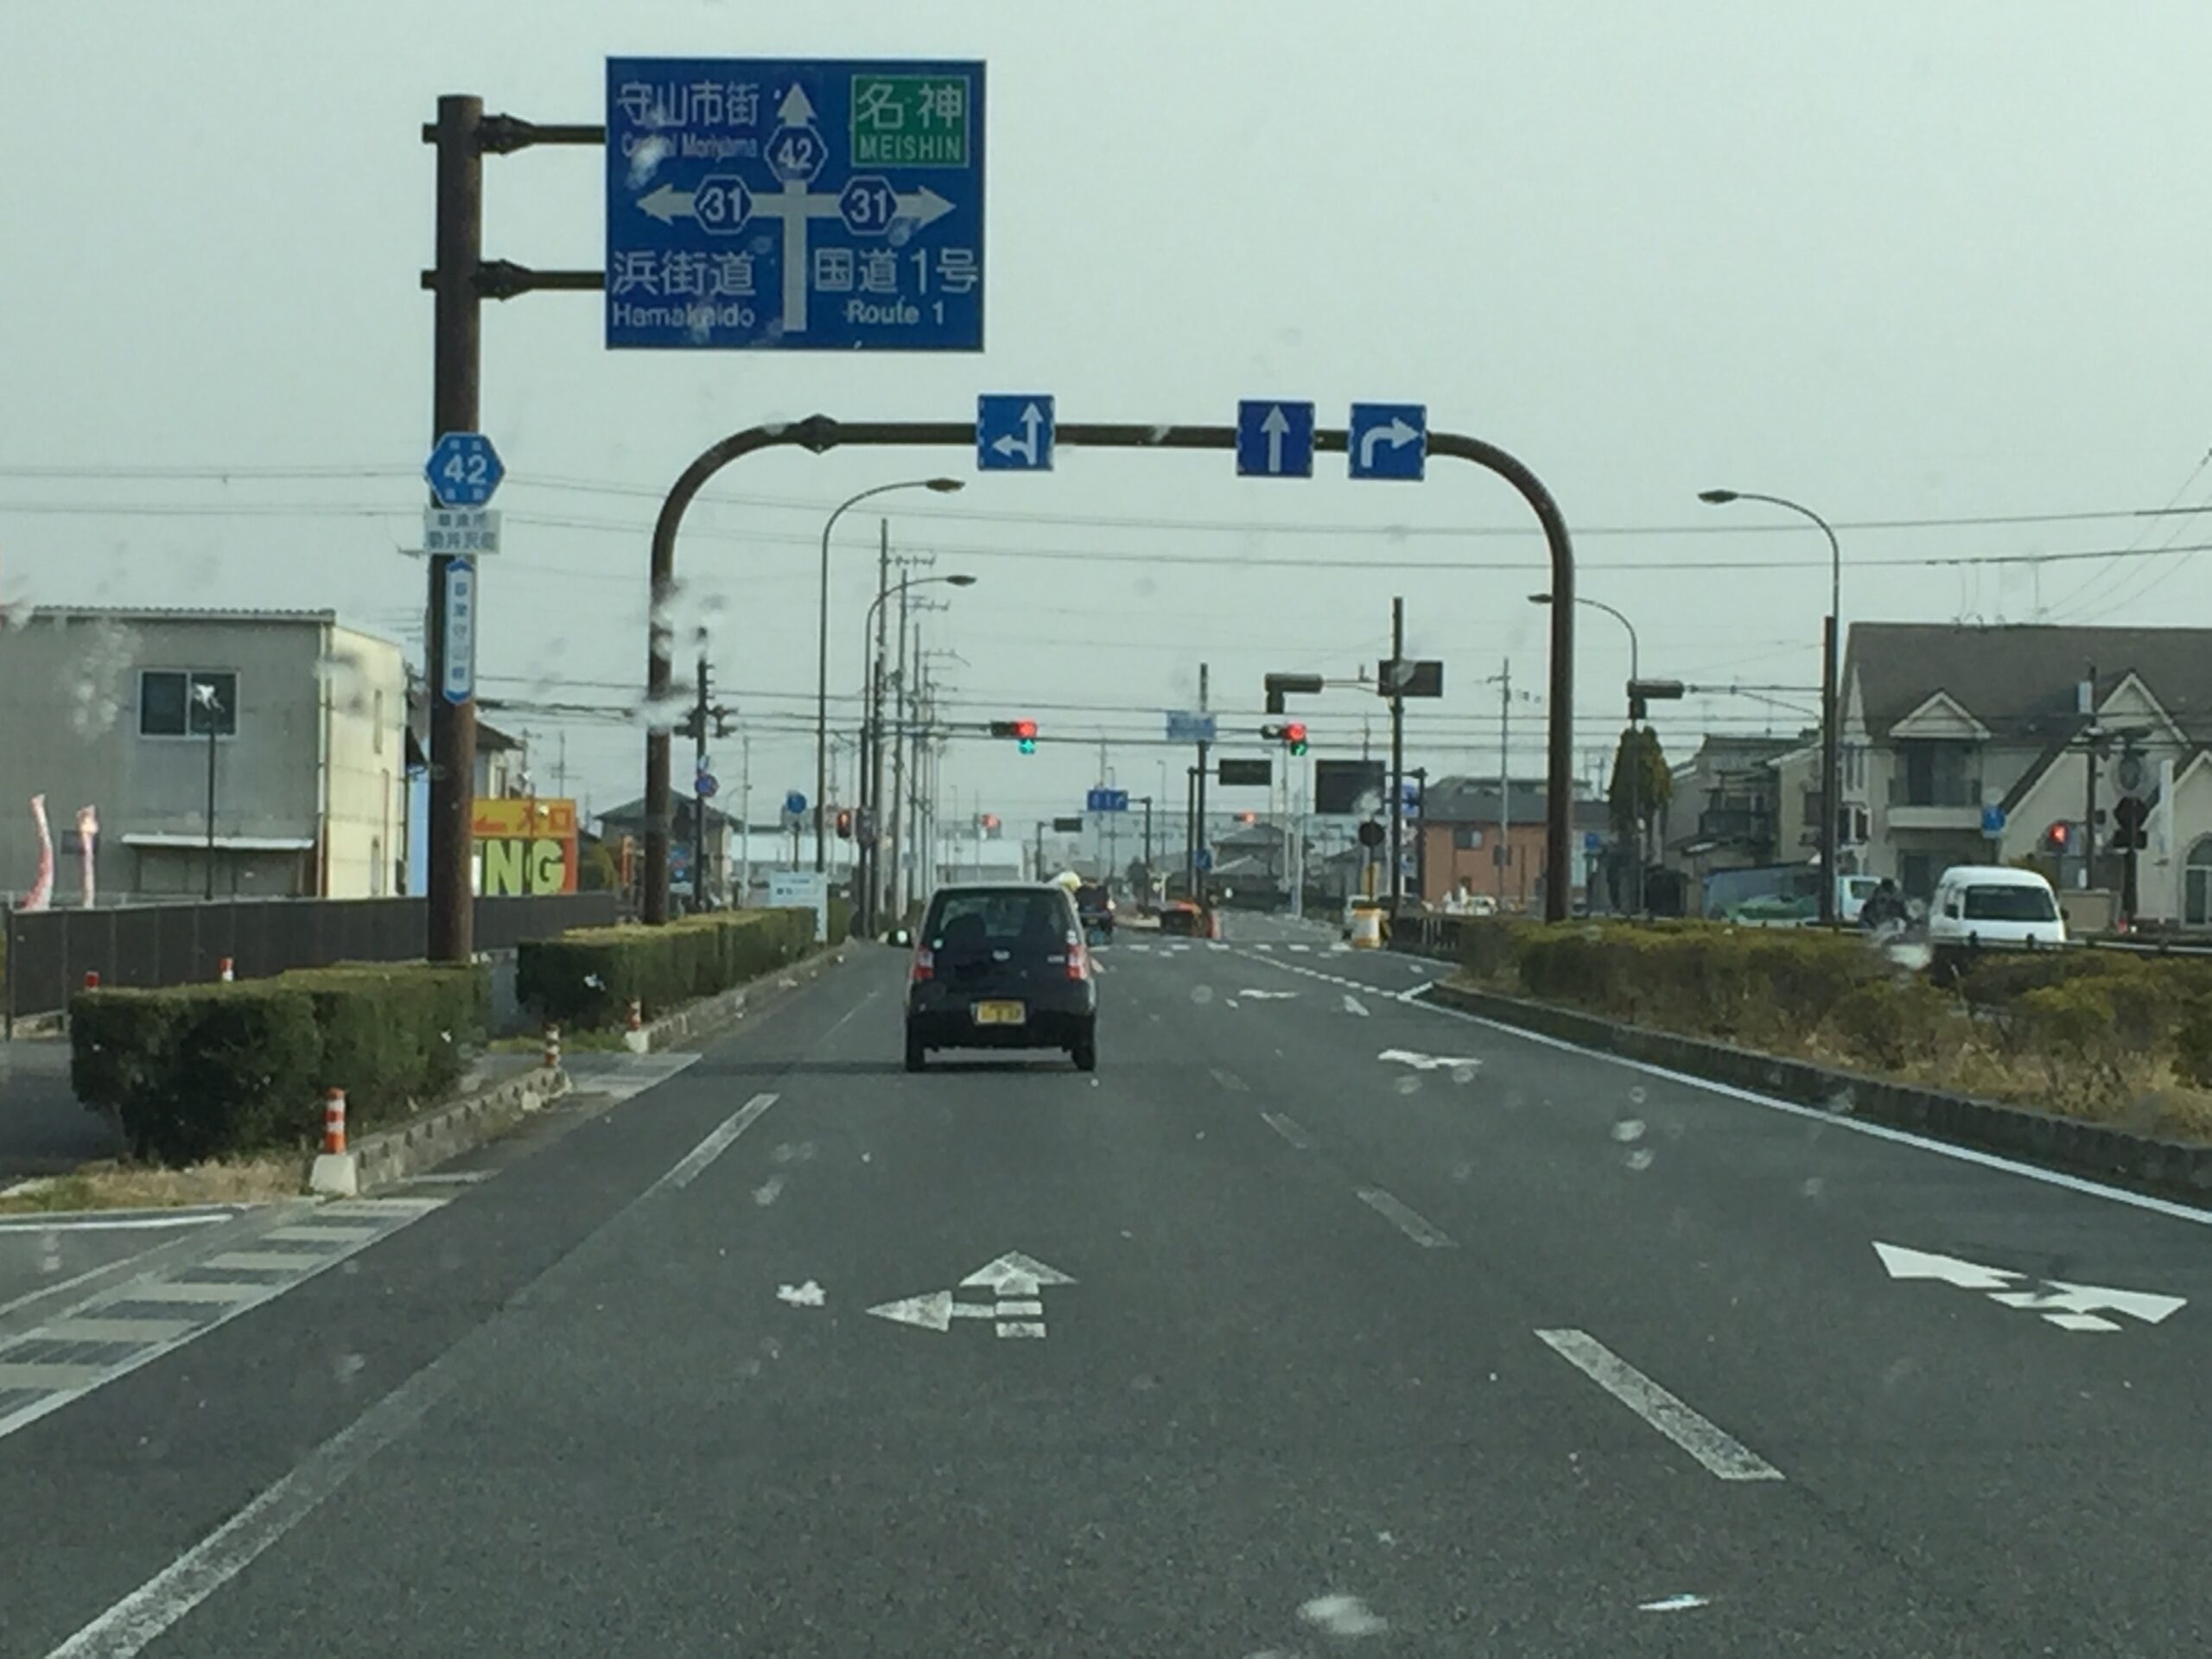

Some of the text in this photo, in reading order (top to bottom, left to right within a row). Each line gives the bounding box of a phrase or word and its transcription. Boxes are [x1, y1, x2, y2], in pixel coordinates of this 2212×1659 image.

[617, 81, 760, 128] 守山市街
[857, 82, 963, 130] 名神
[778, 137, 812, 170] 42
[860, 135, 962, 161] MEISHIN
[704, 189, 742, 223] 31
[849, 189, 888, 223] 31
[612, 251, 756, 296] 浜街道
[815, 248, 978, 296] 国道1号
[613, 302, 755, 328] Hamakaido
[846, 300, 944, 326] Route 1
[443, 454, 487, 485] 42
